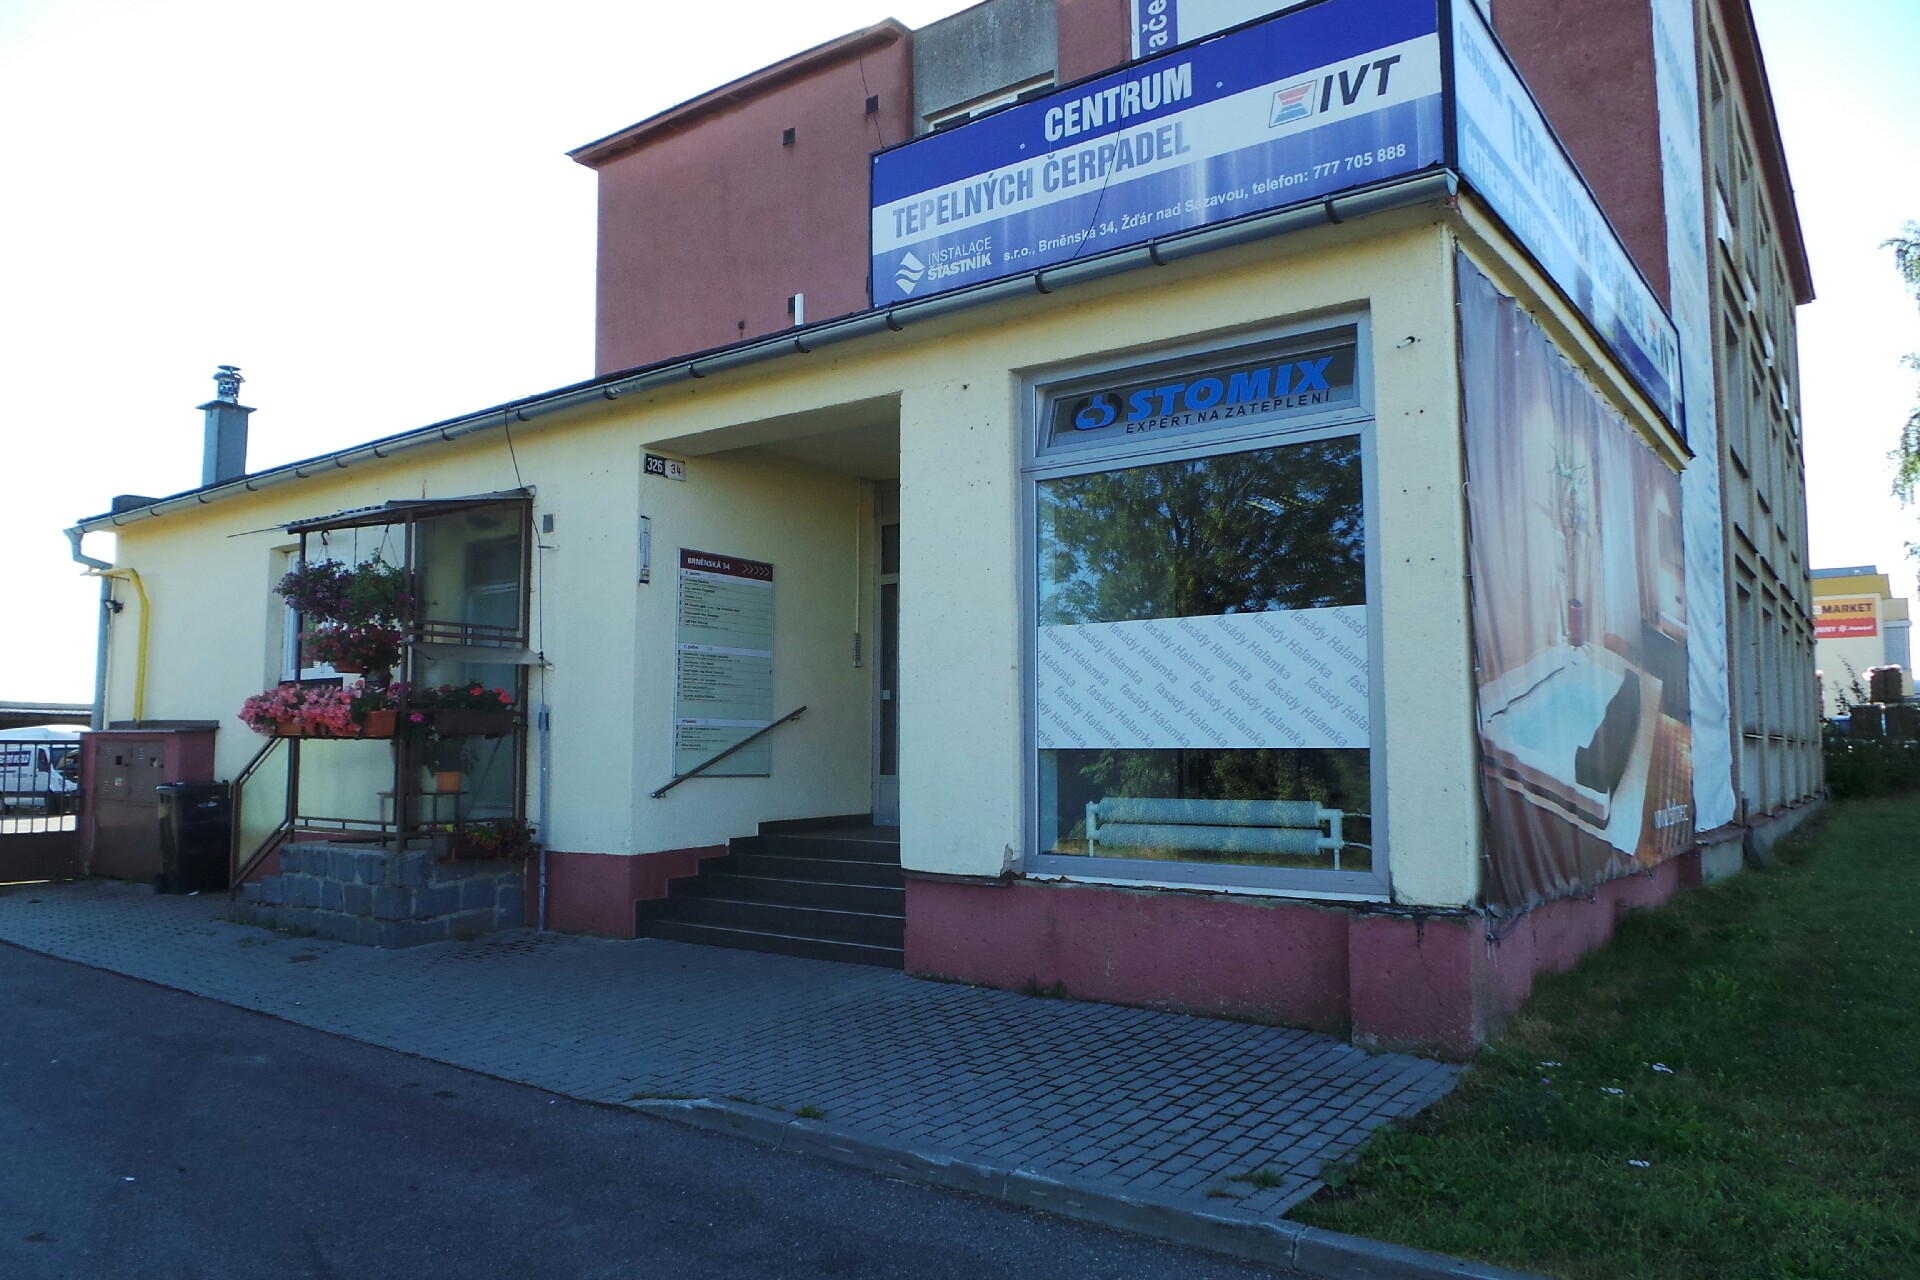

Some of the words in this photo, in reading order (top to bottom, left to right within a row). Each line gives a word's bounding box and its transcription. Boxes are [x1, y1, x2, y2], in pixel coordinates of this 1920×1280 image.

[1142, 0, 1168, 55] ače
[1045, 62, 1192, 142] CENTRUM
[1319, 54, 1400, 113] IVT
[892, 172, 1033, 238] TEPELNÝCH
[1042, 121, 1191, 193] ČERPADEL
[1003, 247, 1035, 261] s.r.o.,
[1038, 228, 1096, 252] Brněnská
[1099, 221, 1118, 236] 34,
[1121, 211, 1152, 230] Žďár
[1156, 203, 1181, 220] nad
[1185, 187, 1248, 213] Sázavou,
[1252, 171, 1309, 195] telefon:
[1312, 161, 1340, 179] 777
[1344, 152, 1373, 171] 705
[1377, 144, 1406, 162] 888
[927, 252, 992, 281] ŠŤASTNÍK
[928, 236, 992, 265] INSTALACE
[1127, 356, 1334, 422] STOMIX
[1126, 414, 1194, 434] EXPERT
[1197, 410, 1219, 423] NA
[1225, 389, 1331, 418] ZATEPLENÍ
[647, 457, 663, 472] 326
[670, 463, 681, 476] 34
[1822, 603, 1873, 614] MARKET
[1040, 652, 1076, 687] Halamka
[1071, 650, 1109, 686] Halamka
[1105, 648, 1143, 685] Halamka
[1138, 646, 1178, 684] Halamka
[1172, 645, 1215, 683] Halamka
[1209, 643, 1252, 681] Halamka
[1247, 640, 1291, 680] Halamka
[1285, 638, 1333, 679] Halamka
[1326, 636, 1369, 675] Halamk
[1265, 678, 1302, 711] fasády
[1300, 706, 1348, 747] Halamka
[1305, 676, 1344, 709] fasády
[1049, 712, 1087, 748] Halamka
[1054, 686, 1083, 715] fasády
[1082, 711, 1120, 748] Halamka
[1086, 684, 1118, 714] fasády
[1115, 710, 1154, 748] Halamka
[1119, 683, 1151, 713] fasády
[1149, 709, 1190, 747] Halamka
[1154, 682, 1187, 713] fasády
[1185, 709, 1228, 747] Halamka
[1190, 681, 1225, 712] fasády
[1222, 707, 1266, 747] Halamka
[1227, 679, 1263, 711] fasády
[1260, 707, 1306, 747] Halamka
